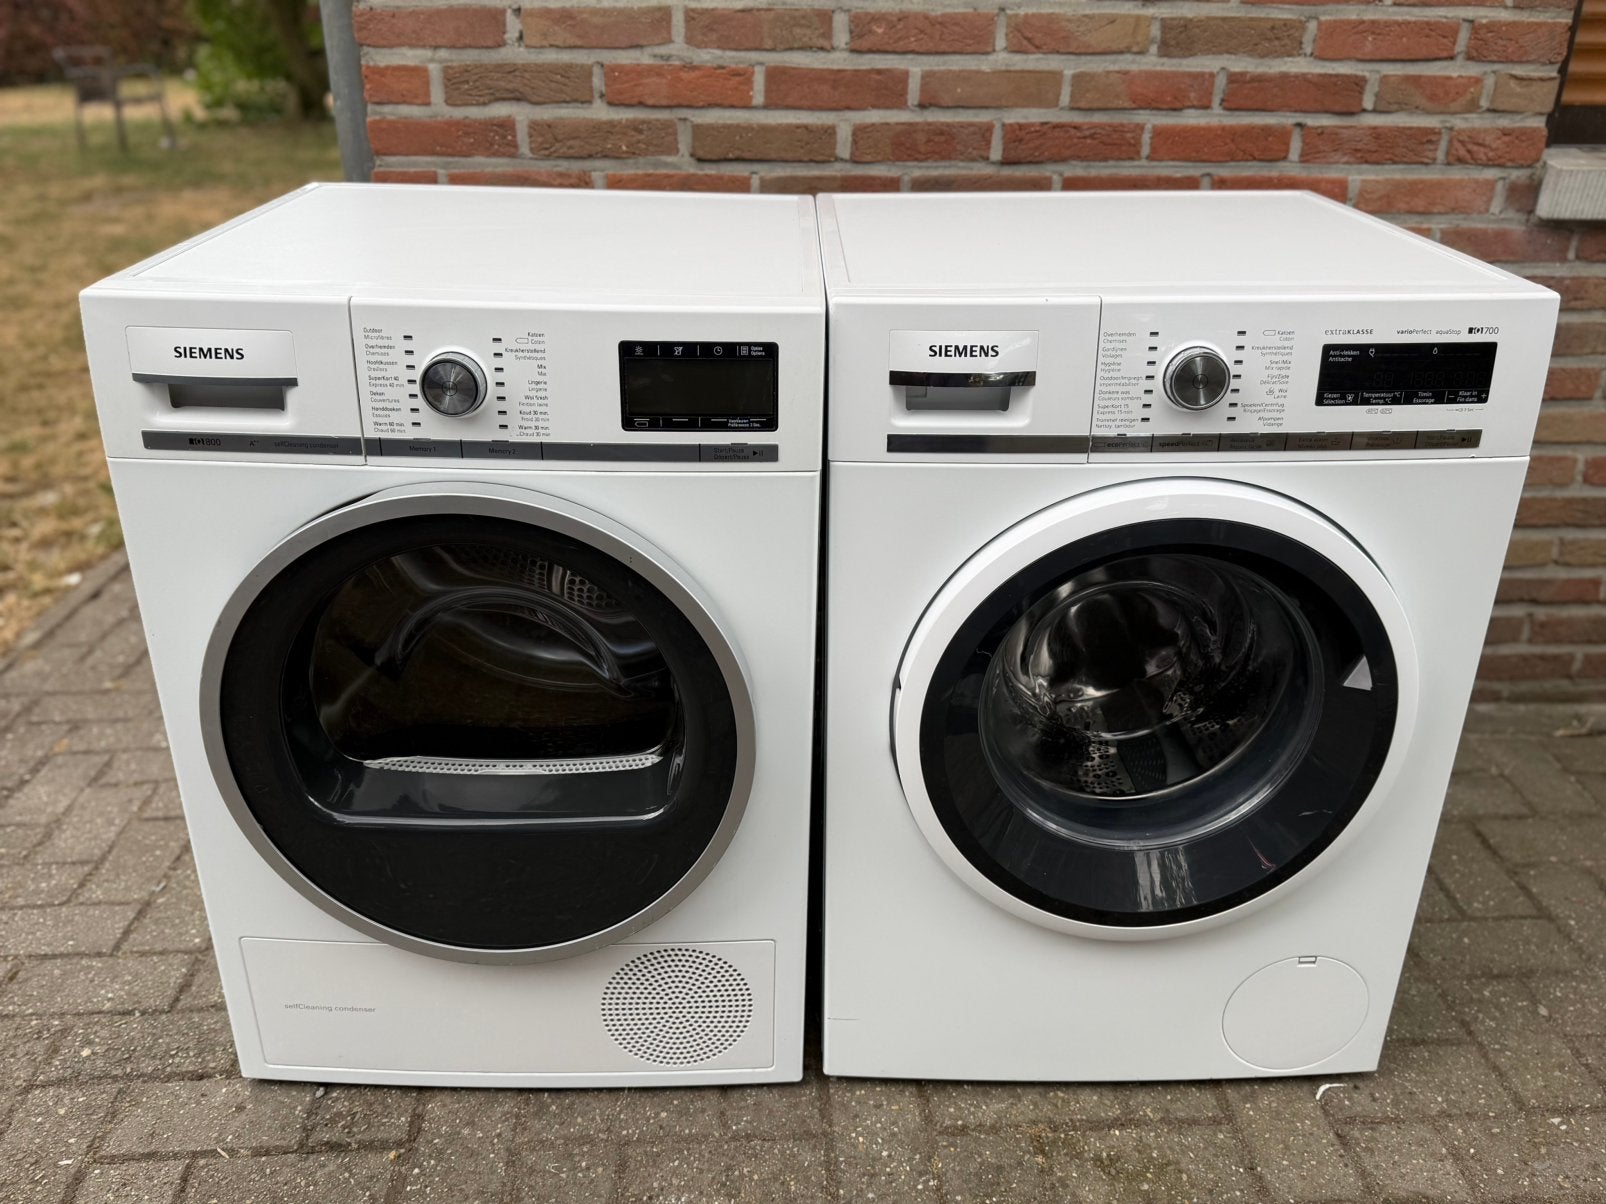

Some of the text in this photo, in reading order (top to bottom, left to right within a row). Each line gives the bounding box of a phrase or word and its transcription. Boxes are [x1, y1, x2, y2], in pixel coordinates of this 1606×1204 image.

[1325, 328, 1374, 336] extraKLASSE
[173, 346, 245, 360] SIEMENS
[929, 345, 1000, 358] SIEMENS
[409, 445, 432, 453] Memory
[488, 447, 511, 455] Memory
[285, 1003, 333, 1012] selfCleaning
